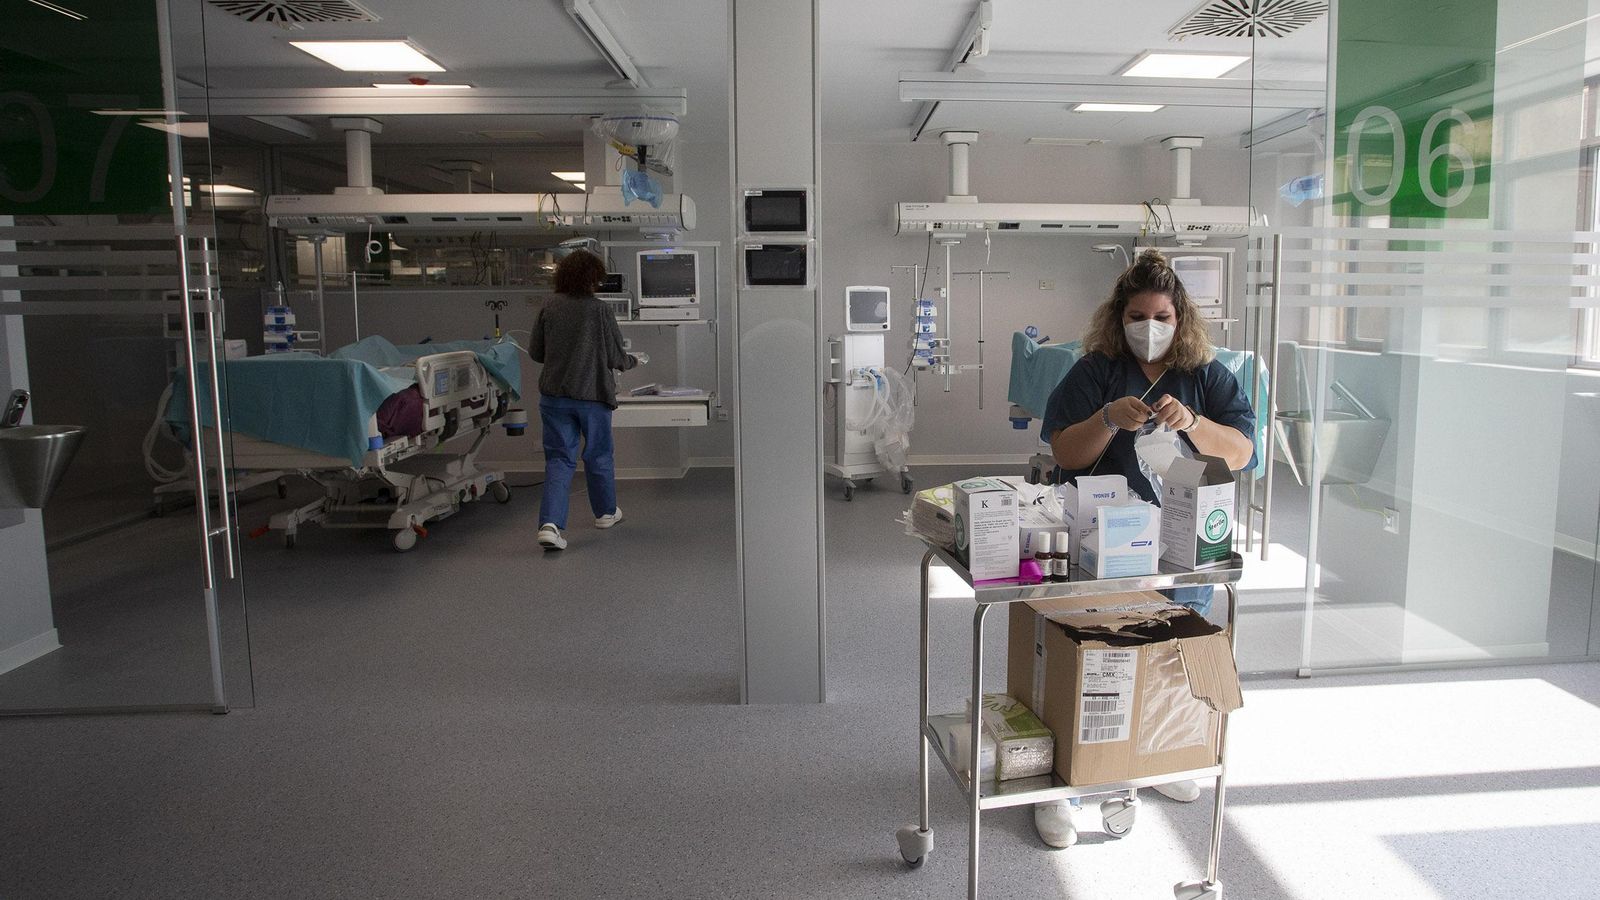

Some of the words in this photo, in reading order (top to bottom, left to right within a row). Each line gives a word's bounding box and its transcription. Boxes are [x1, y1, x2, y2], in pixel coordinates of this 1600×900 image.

[0, 91, 141, 203] 07
[1347, 105, 1476, 208] 06
[981, 500, 989, 509] K
[1208, 519, 1225, 531] Sterile
